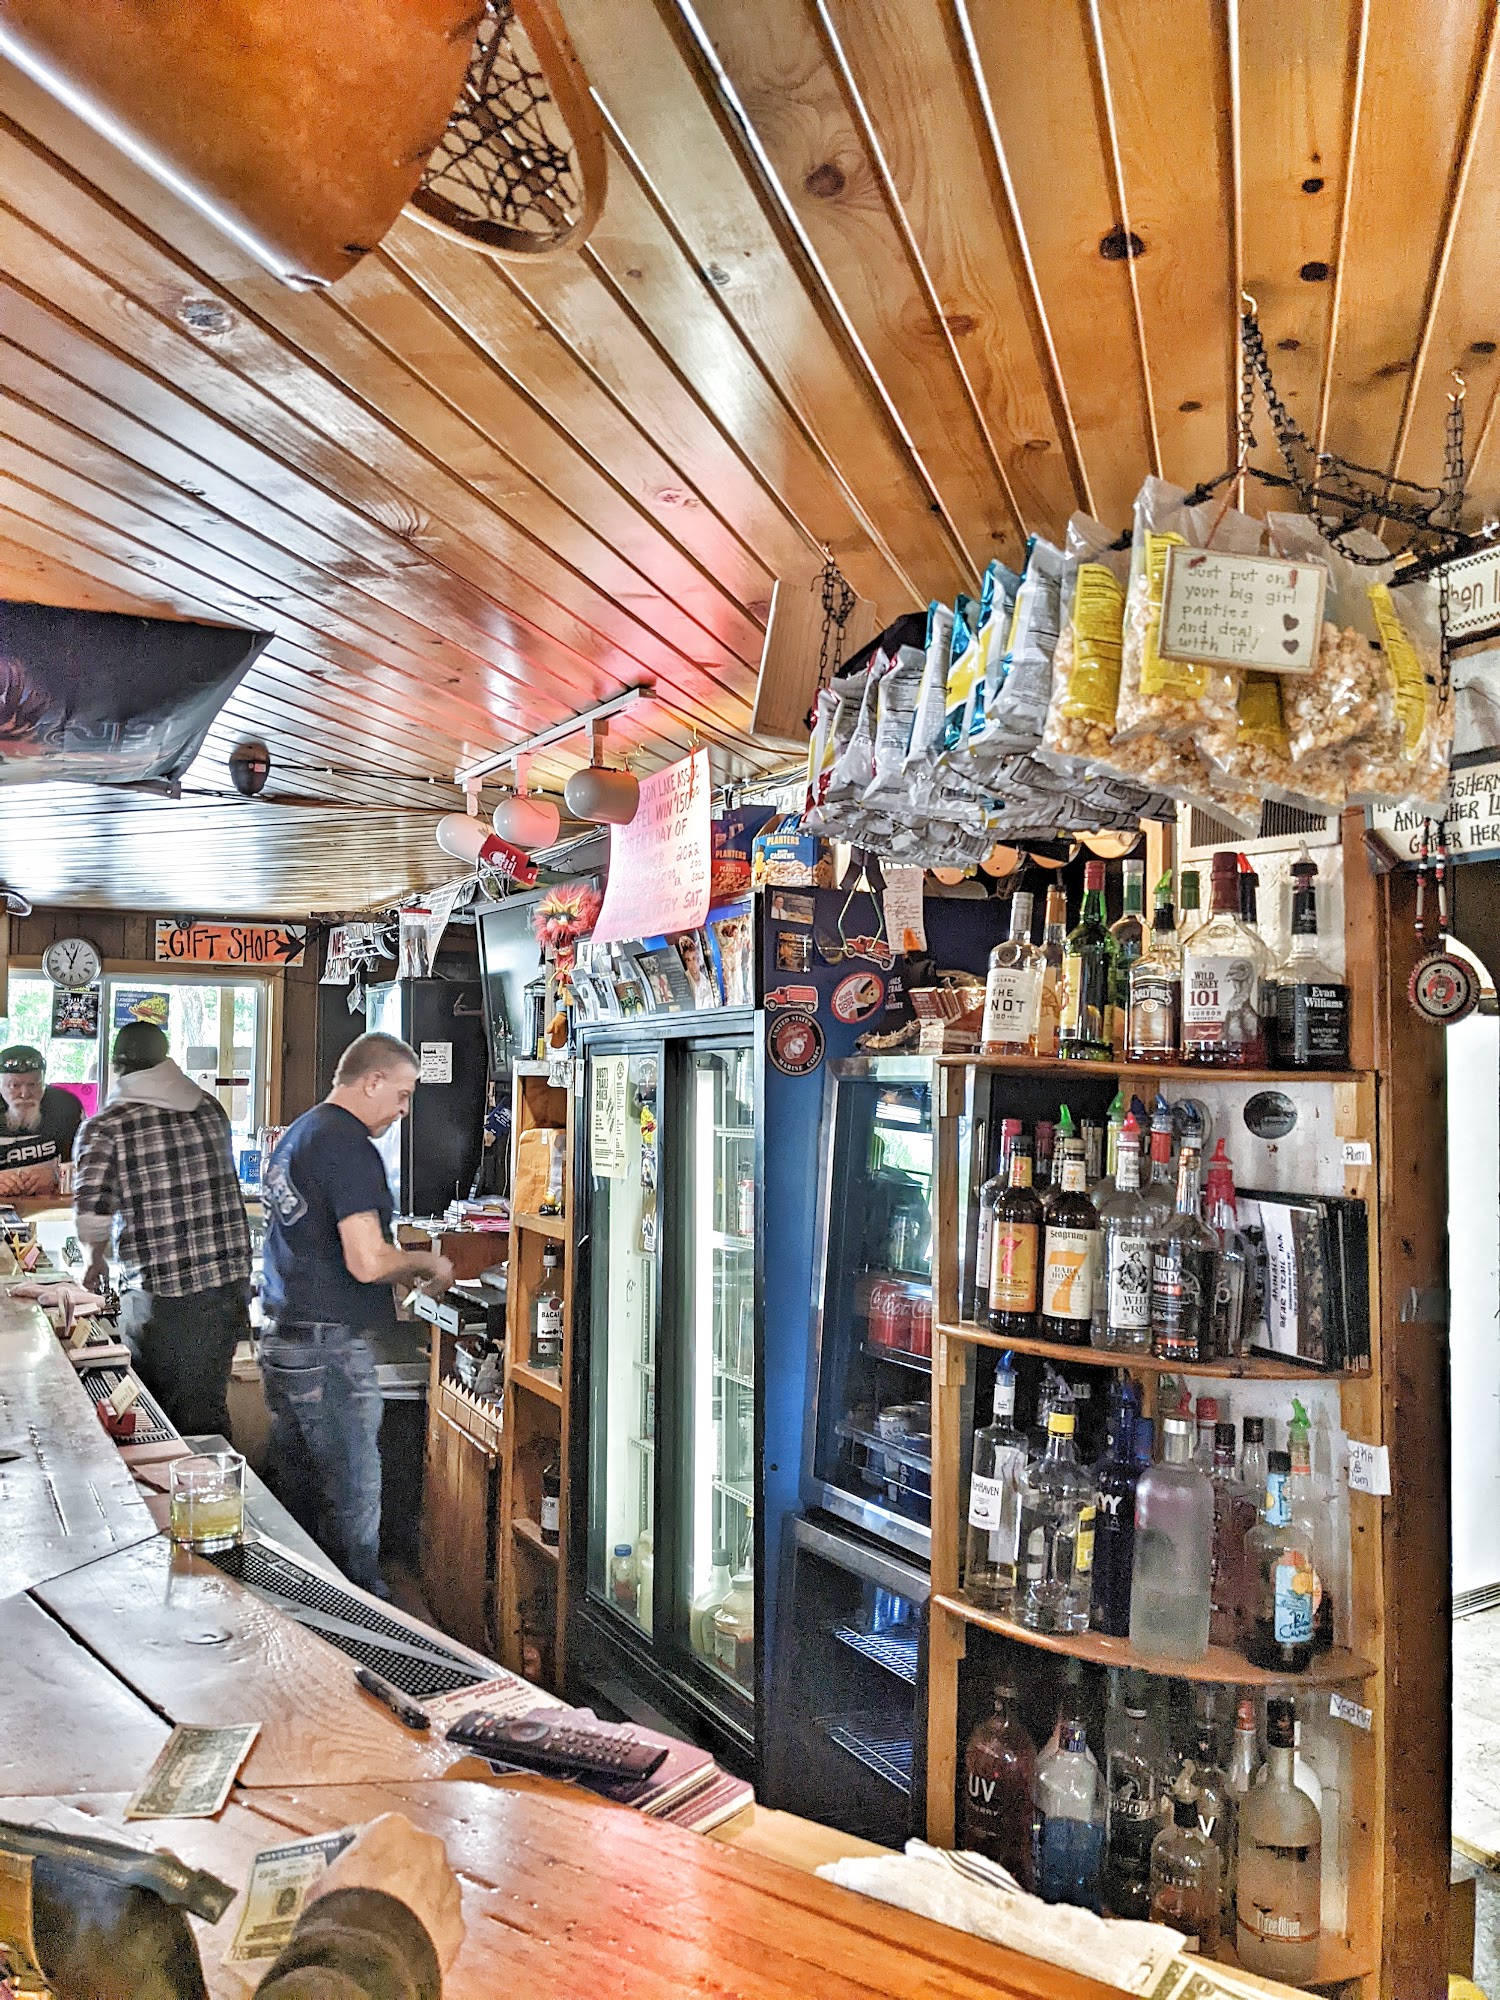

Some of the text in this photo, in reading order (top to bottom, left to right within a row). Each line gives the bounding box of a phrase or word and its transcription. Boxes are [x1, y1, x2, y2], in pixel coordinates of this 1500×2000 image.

[1230, 569, 1259, 583] put
[1266, 573, 1286, 585] on
[1184, 584, 1298, 606] your big girl
[1178, 636, 1259, 655] with it!
[641, 783, 657, 804] SON
[659, 774, 676, 796] LAKE
[1450, 774, 1500, 798] ISHERM
[655, 798, 673, 820] WIN
[1393, 793, 1500, 832] AND HER LI
[656, 823, 673, 844] DAY
[674, 817, 689, 837] OF
[1470, 823, 1500, 846] HER
[767, 835, 800, 846] PLANTERS
[715, 849, 747, 860] PLANTERS
[683, 889, 703, 910] SAT.
[168, 927, 280, 962] GIFT SHOP
[1194, 971, 1215, 980] WILD
[992, 988, 1014, 997] THE
[1191, 979, 1219, 990] TURKEY
[1311, 986, 1337, 998] Evan
[990, 999, 1026, 1013] NOT
[1190, 990, 1220, 1007] 101
[1303, 997, 1344, 1009] Williams
[772, 1014, 813, 1039] UNITED STATES
[778, 1045, 821, 1072] MARINE CORPS
[0, 1140, 57, 1164] LARIS
[1050, 1230, 1088, 1242] Seagram's
[1120, 1241, 1145, 1253] Captain
[1051, 1272, 1082, 1281] HONEY
[1054, 1266, 1078, 1274] DARK
[1123, 1295, 1148, 1305] WHI
[541, 1311, 560, 1319] BACA
[1130, 1305, 1149, 1316] RU
[968, 1773, 996, 1803] UV
[1197, 1814, 1216, 1838] V
